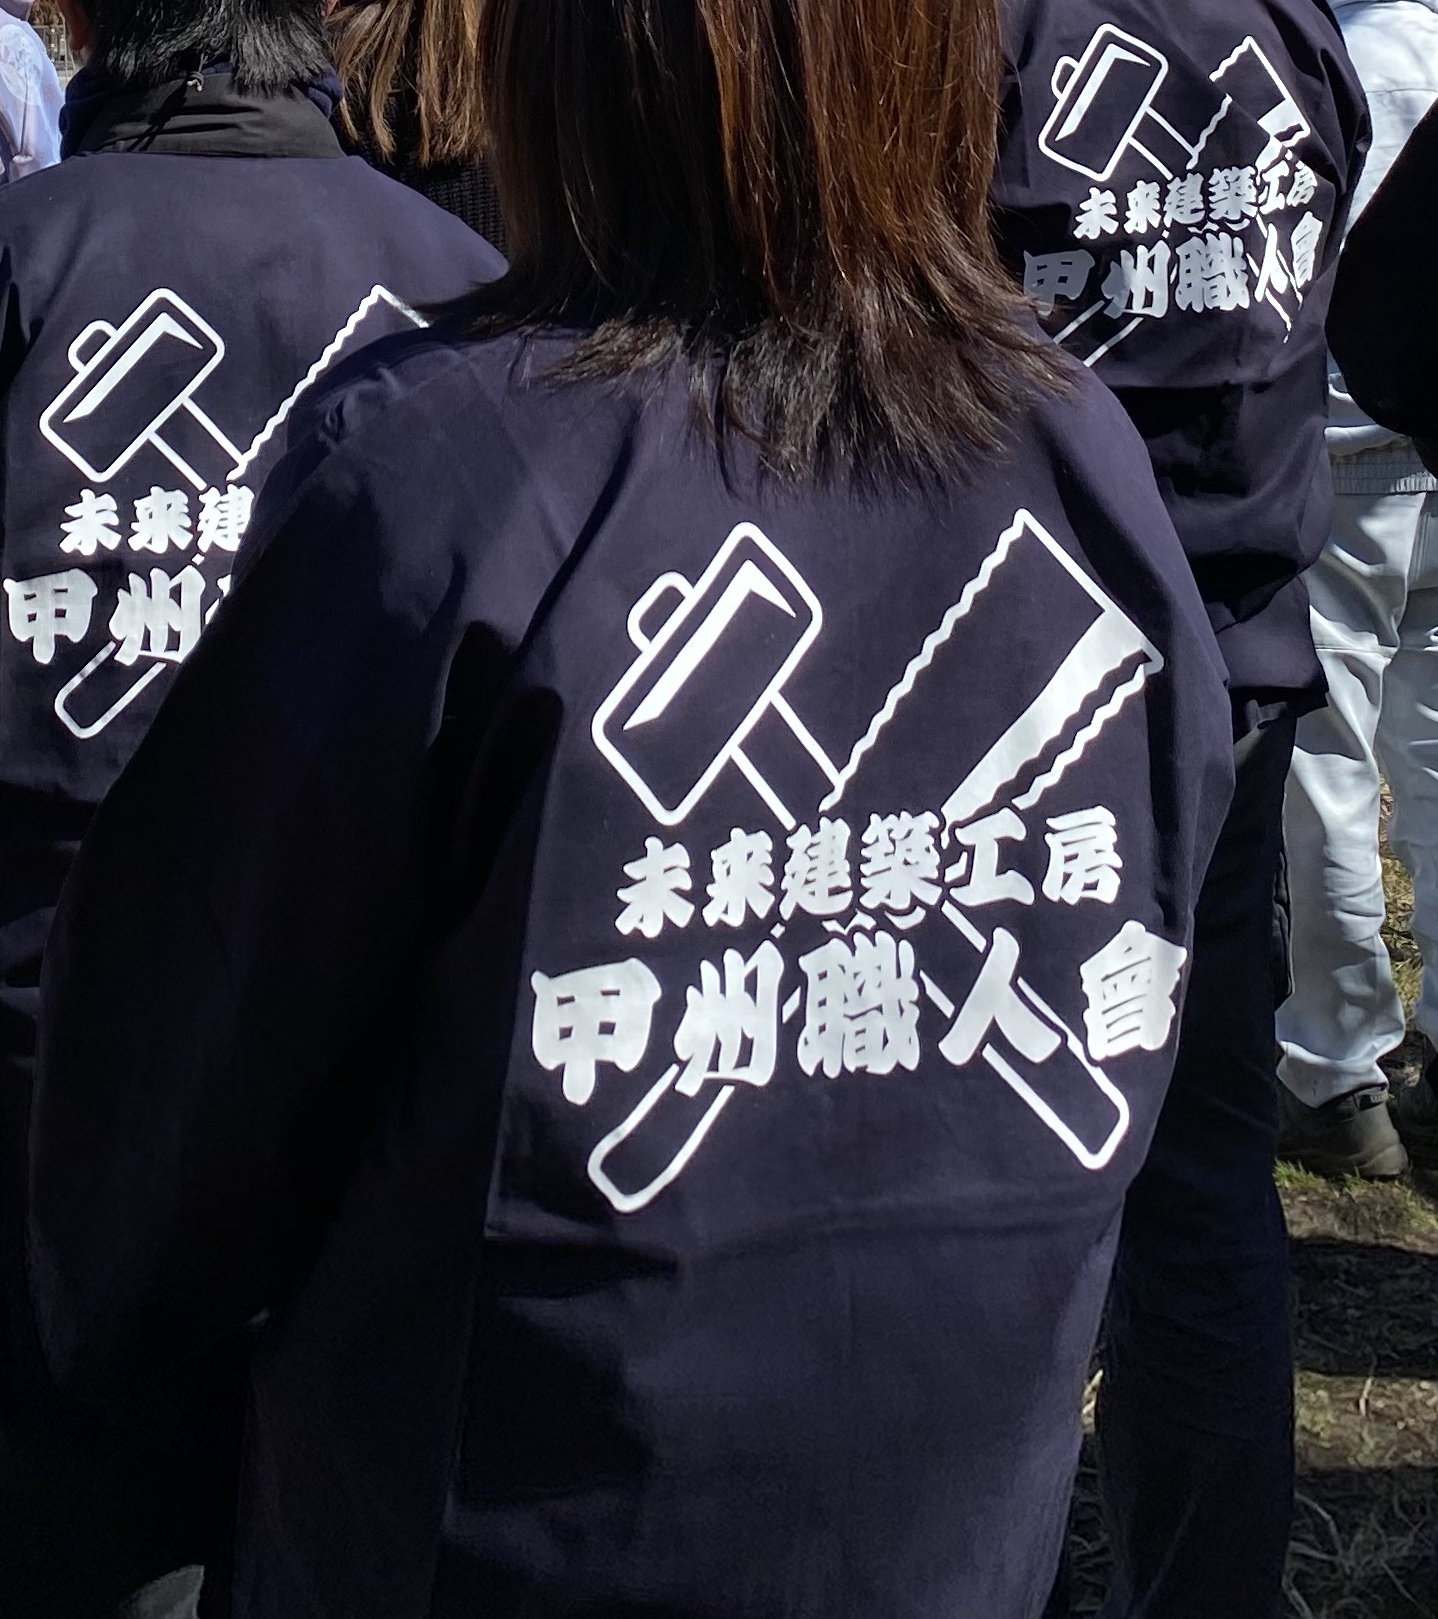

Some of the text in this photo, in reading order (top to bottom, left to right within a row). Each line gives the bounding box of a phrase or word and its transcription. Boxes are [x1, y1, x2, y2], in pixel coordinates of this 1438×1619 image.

[1073, 161, 1319, 240] 未来建築工房
[2, 565, 234, 666] 甲州
[614, 807, 1124, 939] 未来建築工房
